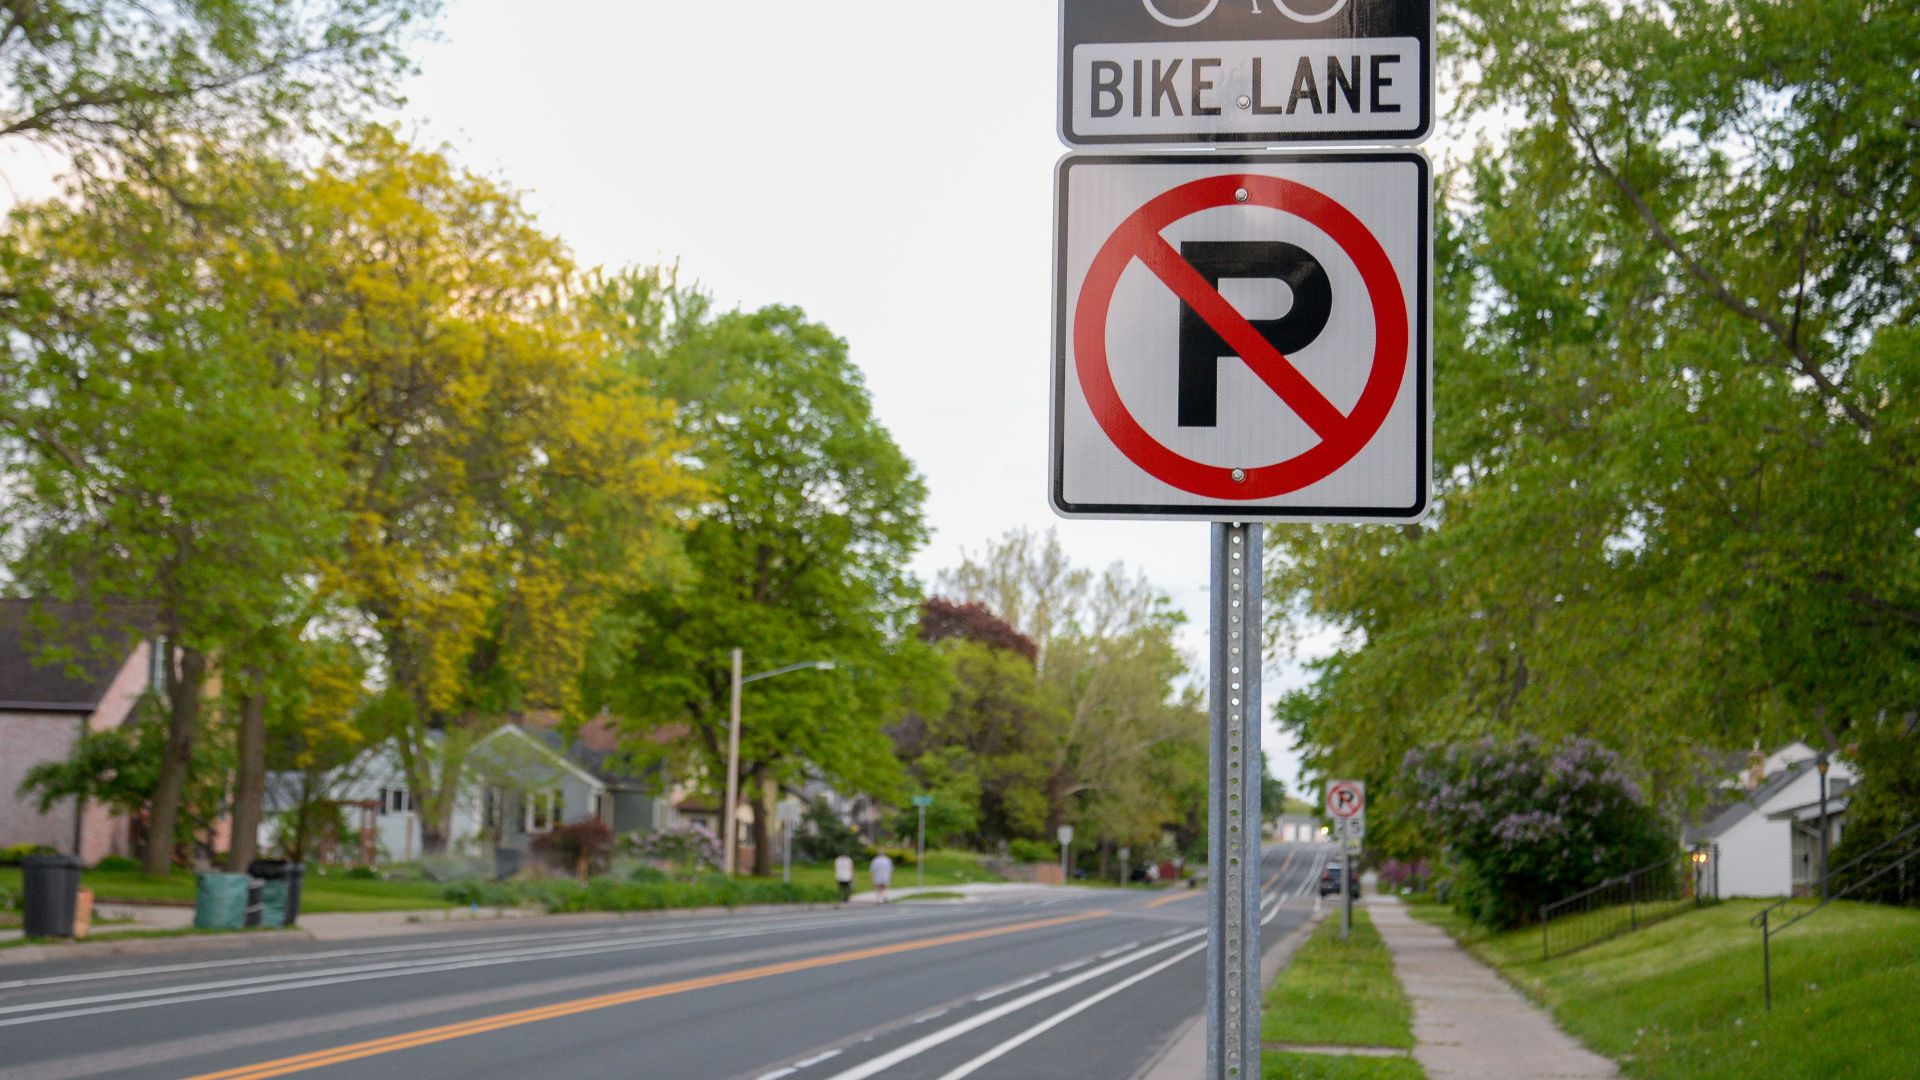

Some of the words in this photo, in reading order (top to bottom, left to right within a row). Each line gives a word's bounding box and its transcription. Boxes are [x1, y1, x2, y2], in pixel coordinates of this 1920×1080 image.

[1090, 58, 1222, 118] BIKE
[1251, 55, 1401, 116] LANE
[1177, 240, 1333, 428] P
[1338, 790, 1354, 808] P
